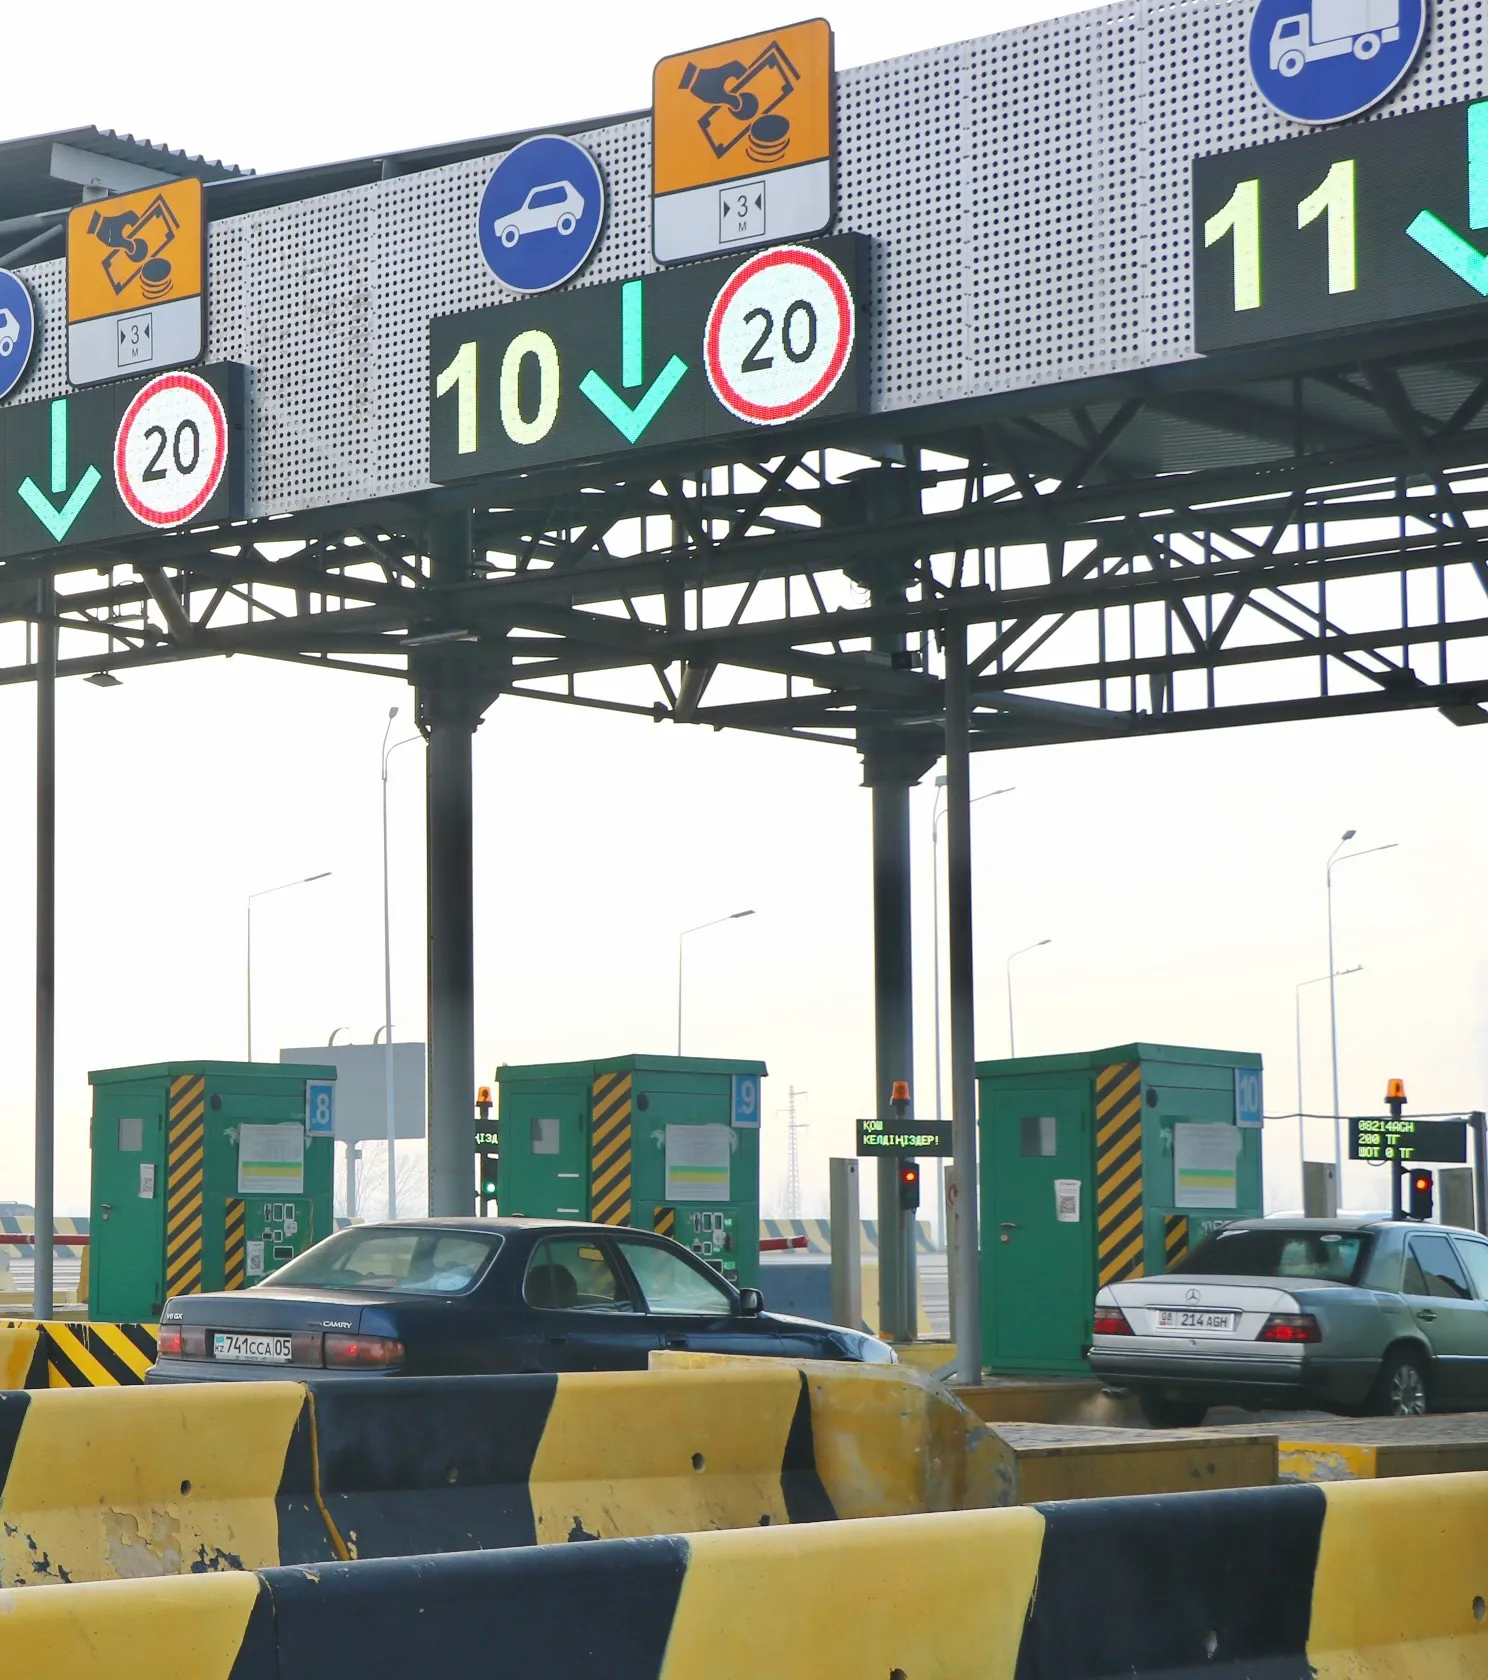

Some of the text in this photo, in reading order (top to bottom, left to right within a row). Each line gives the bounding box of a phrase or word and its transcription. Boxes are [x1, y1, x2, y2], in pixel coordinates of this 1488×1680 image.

[737, 195, 748, 217] 3
[1204, 159, 1356, 311] 11
[131, 325, 139, 344] 3
[741, 300, 817, 373] 20
[436, 329, 560, 455] 10
[142, 419, 199, 482] 20
[741, 1081, 755, 1114] 9
[1239, 1075, 1258, 1112] 10
[316, 1093, 330, 1124] 8
[862, 1120, 884, 1132] ҚОШ
[1358, 1134, 1380, 1145] 200
[323, 1321, 352, 1329] CAMRY
[1181, 1313, 1227, 1328] 214 AGH
[215, 1345, 224, 1353] KZ
